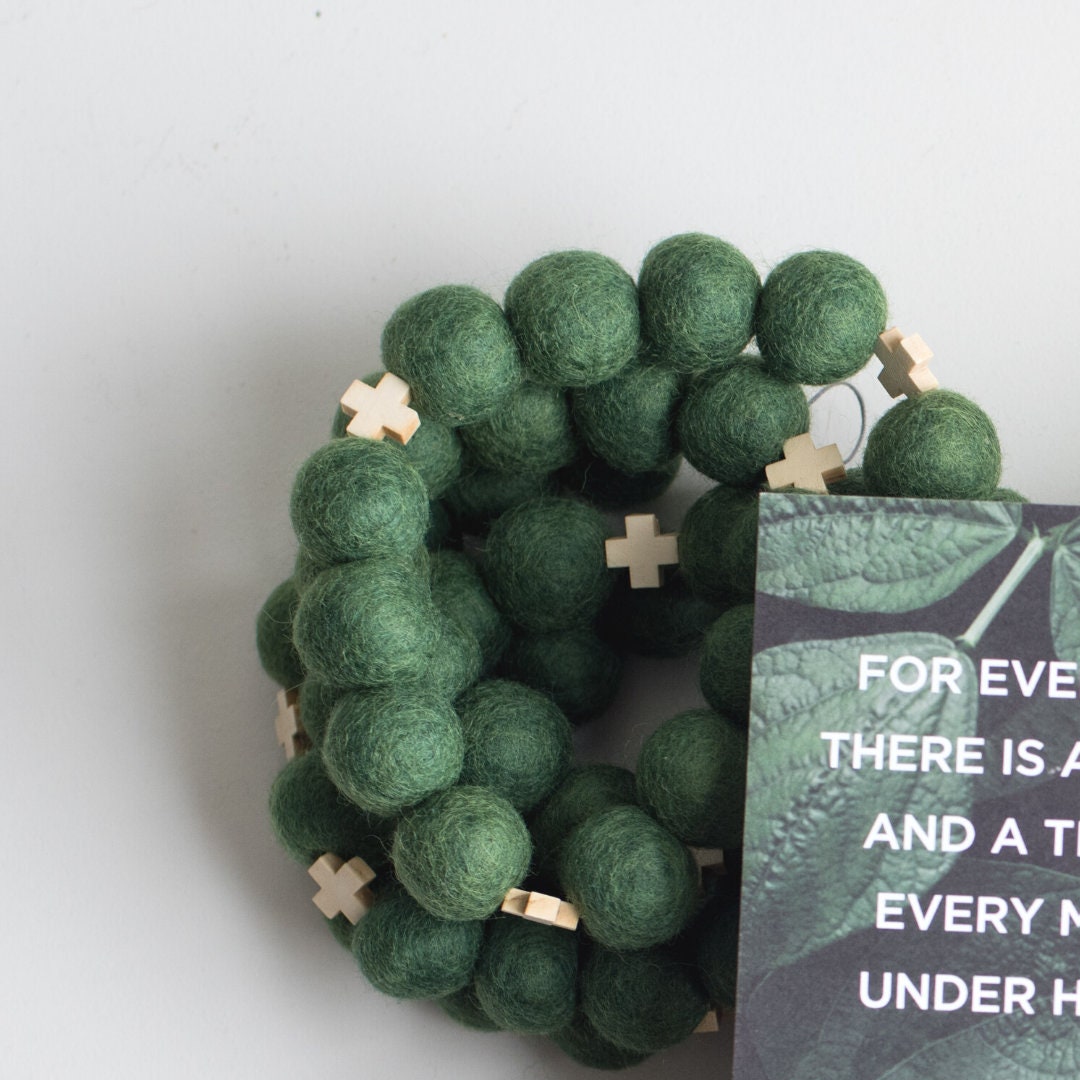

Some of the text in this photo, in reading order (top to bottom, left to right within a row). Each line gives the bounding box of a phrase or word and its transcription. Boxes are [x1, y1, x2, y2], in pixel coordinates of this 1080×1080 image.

[856, 653, 964, 695] FOR
[820, 731, 986, 775] THERE
[1002, 738, 1045, 778] IS
[862, 813, 976, 854] AND
[990, 817, 1028, 855] A
[875, 892, 1045, 935] EVERY
[858, 970, 1036, 1015] UNDER
